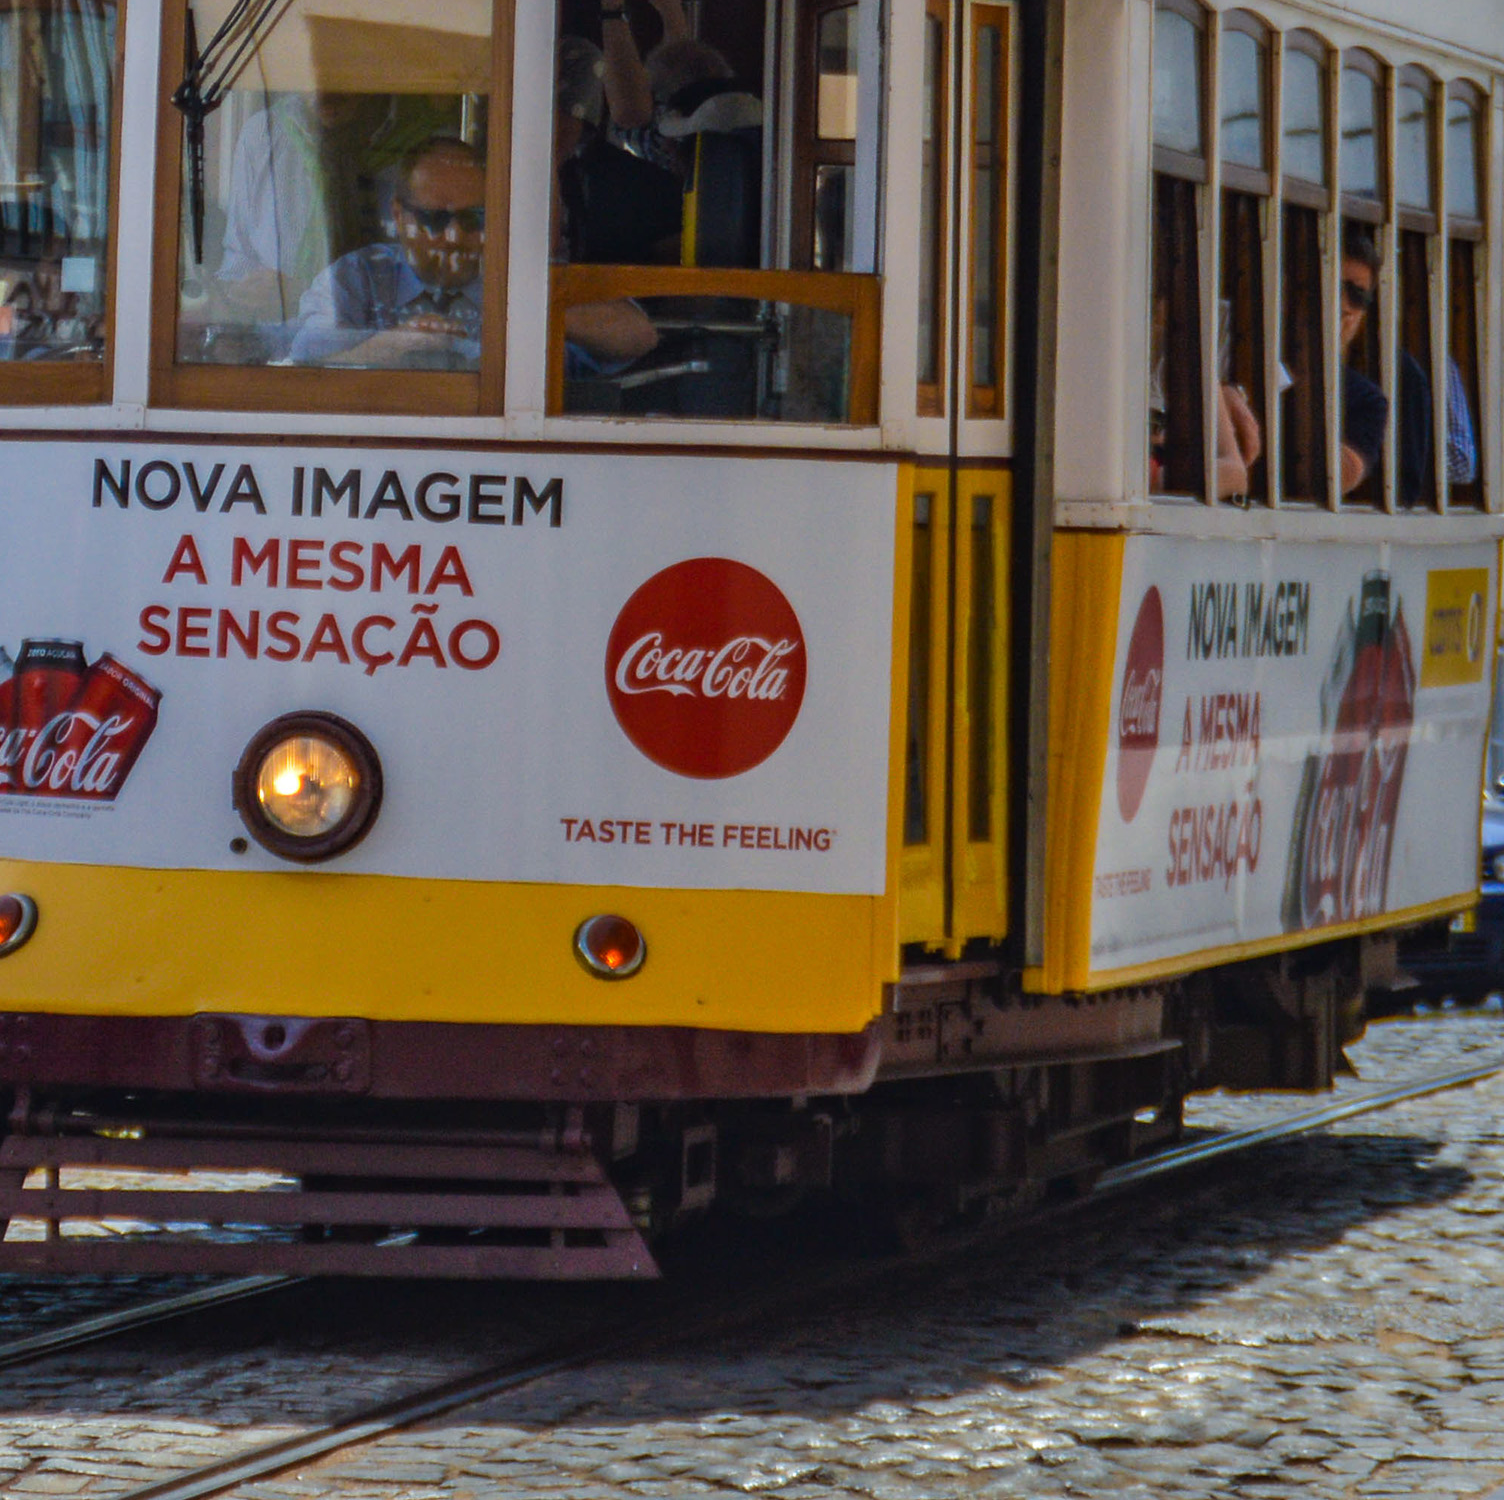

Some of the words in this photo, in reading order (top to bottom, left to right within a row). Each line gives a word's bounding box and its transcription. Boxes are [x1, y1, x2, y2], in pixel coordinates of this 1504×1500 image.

[93, 458, 267, 516] NOVA
[290, 465, 564, 528] IMAGEM
[161, 534, 208, 586] A
[231, 537, 474, 597] MESMA
[137, 603, 500, 677] SENSAÇÃO
[1187, 582, 1237, 660] NOVA
[1242, 581, 1310, 657] IMAGEM
[615, 632, 799, 701] Coca-Cola
[1176, 696, 1192, 773] A
[1196, 691, 1261, 771] MESMA
[560, 818, 651, 844] TASTE
[660, 822, 714, 847] THE
[722, 825, 833, 852] FEELING
